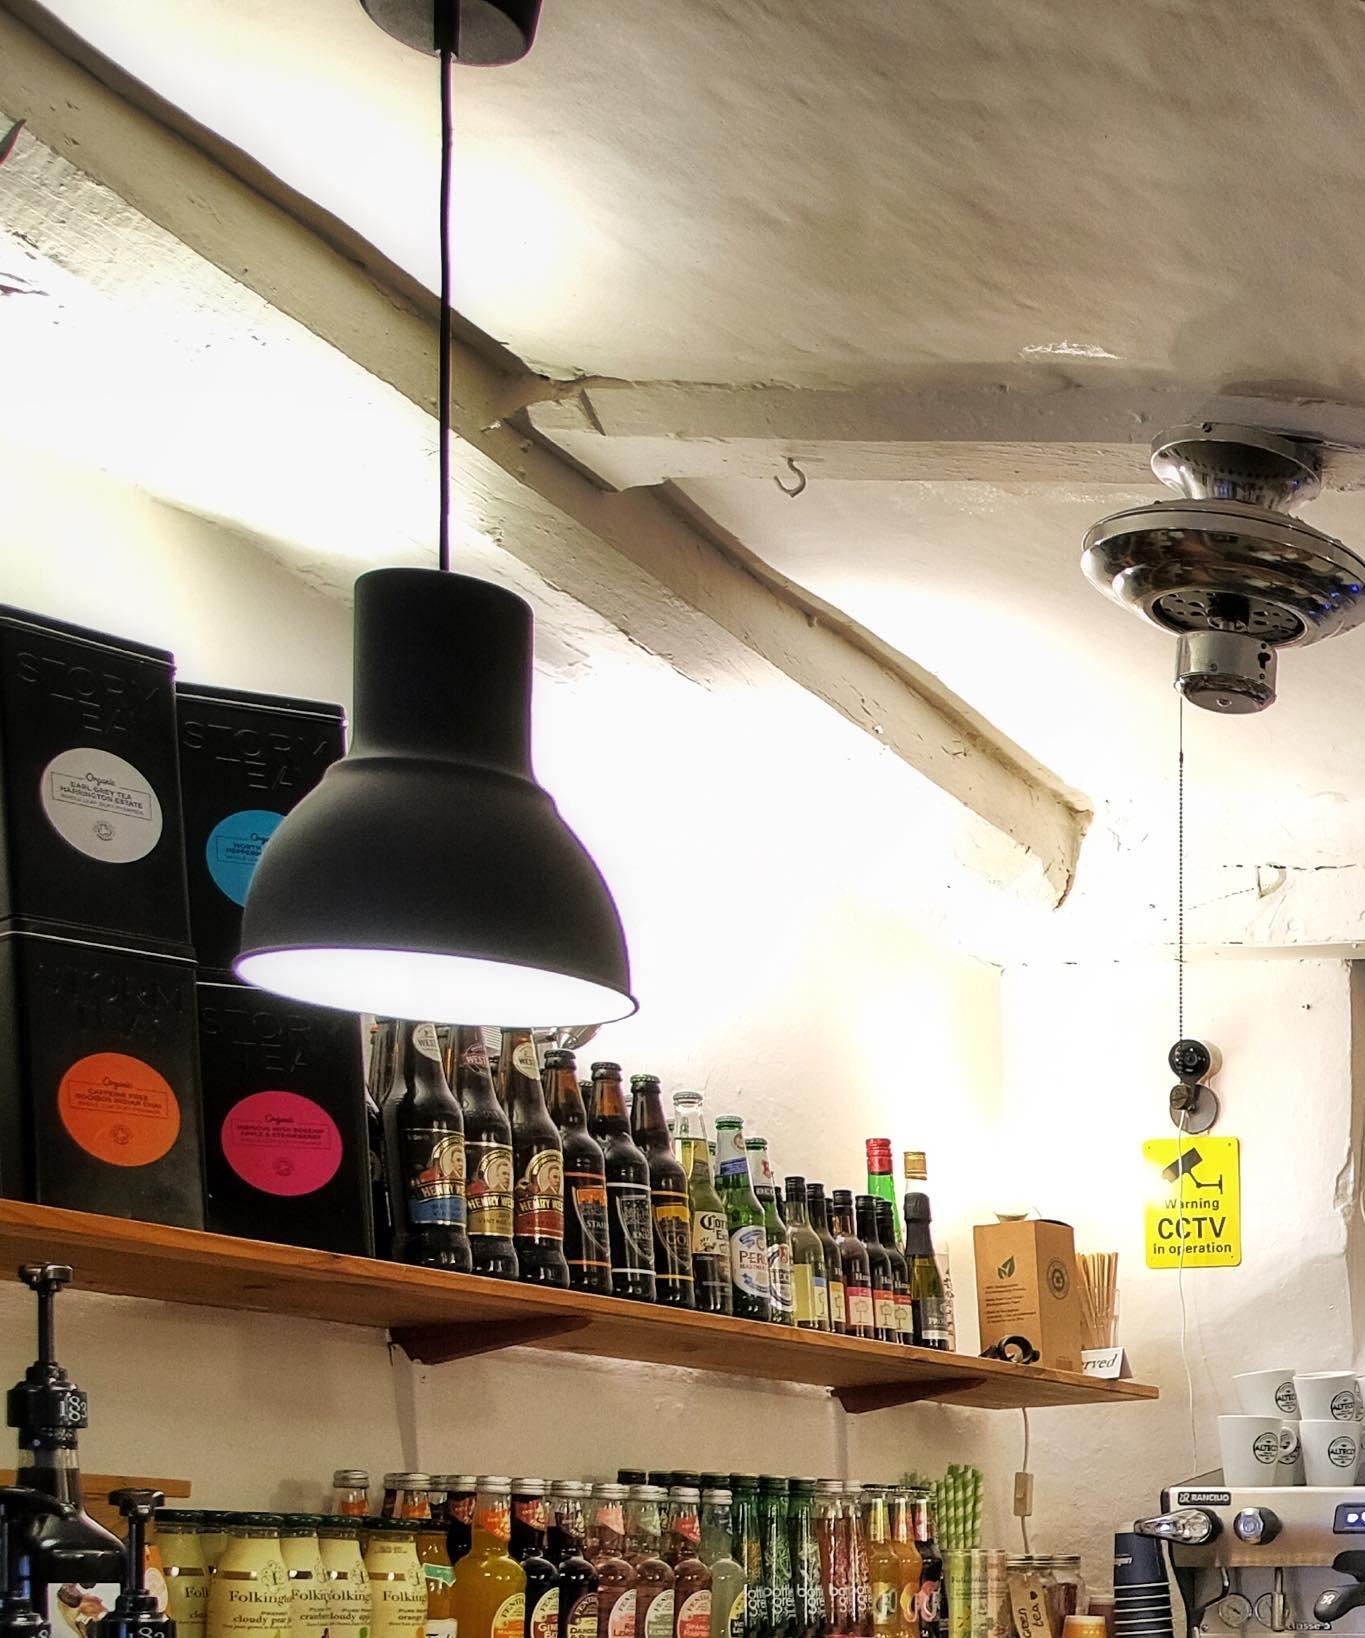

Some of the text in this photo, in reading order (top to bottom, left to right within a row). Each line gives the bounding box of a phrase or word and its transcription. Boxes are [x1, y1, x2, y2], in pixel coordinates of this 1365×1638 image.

[1165, 1198, 1220, 1212] Warning
[1158, 1216, 1227, 1239] CCTV
[1153, 1242, 1233, 1257] in operation
